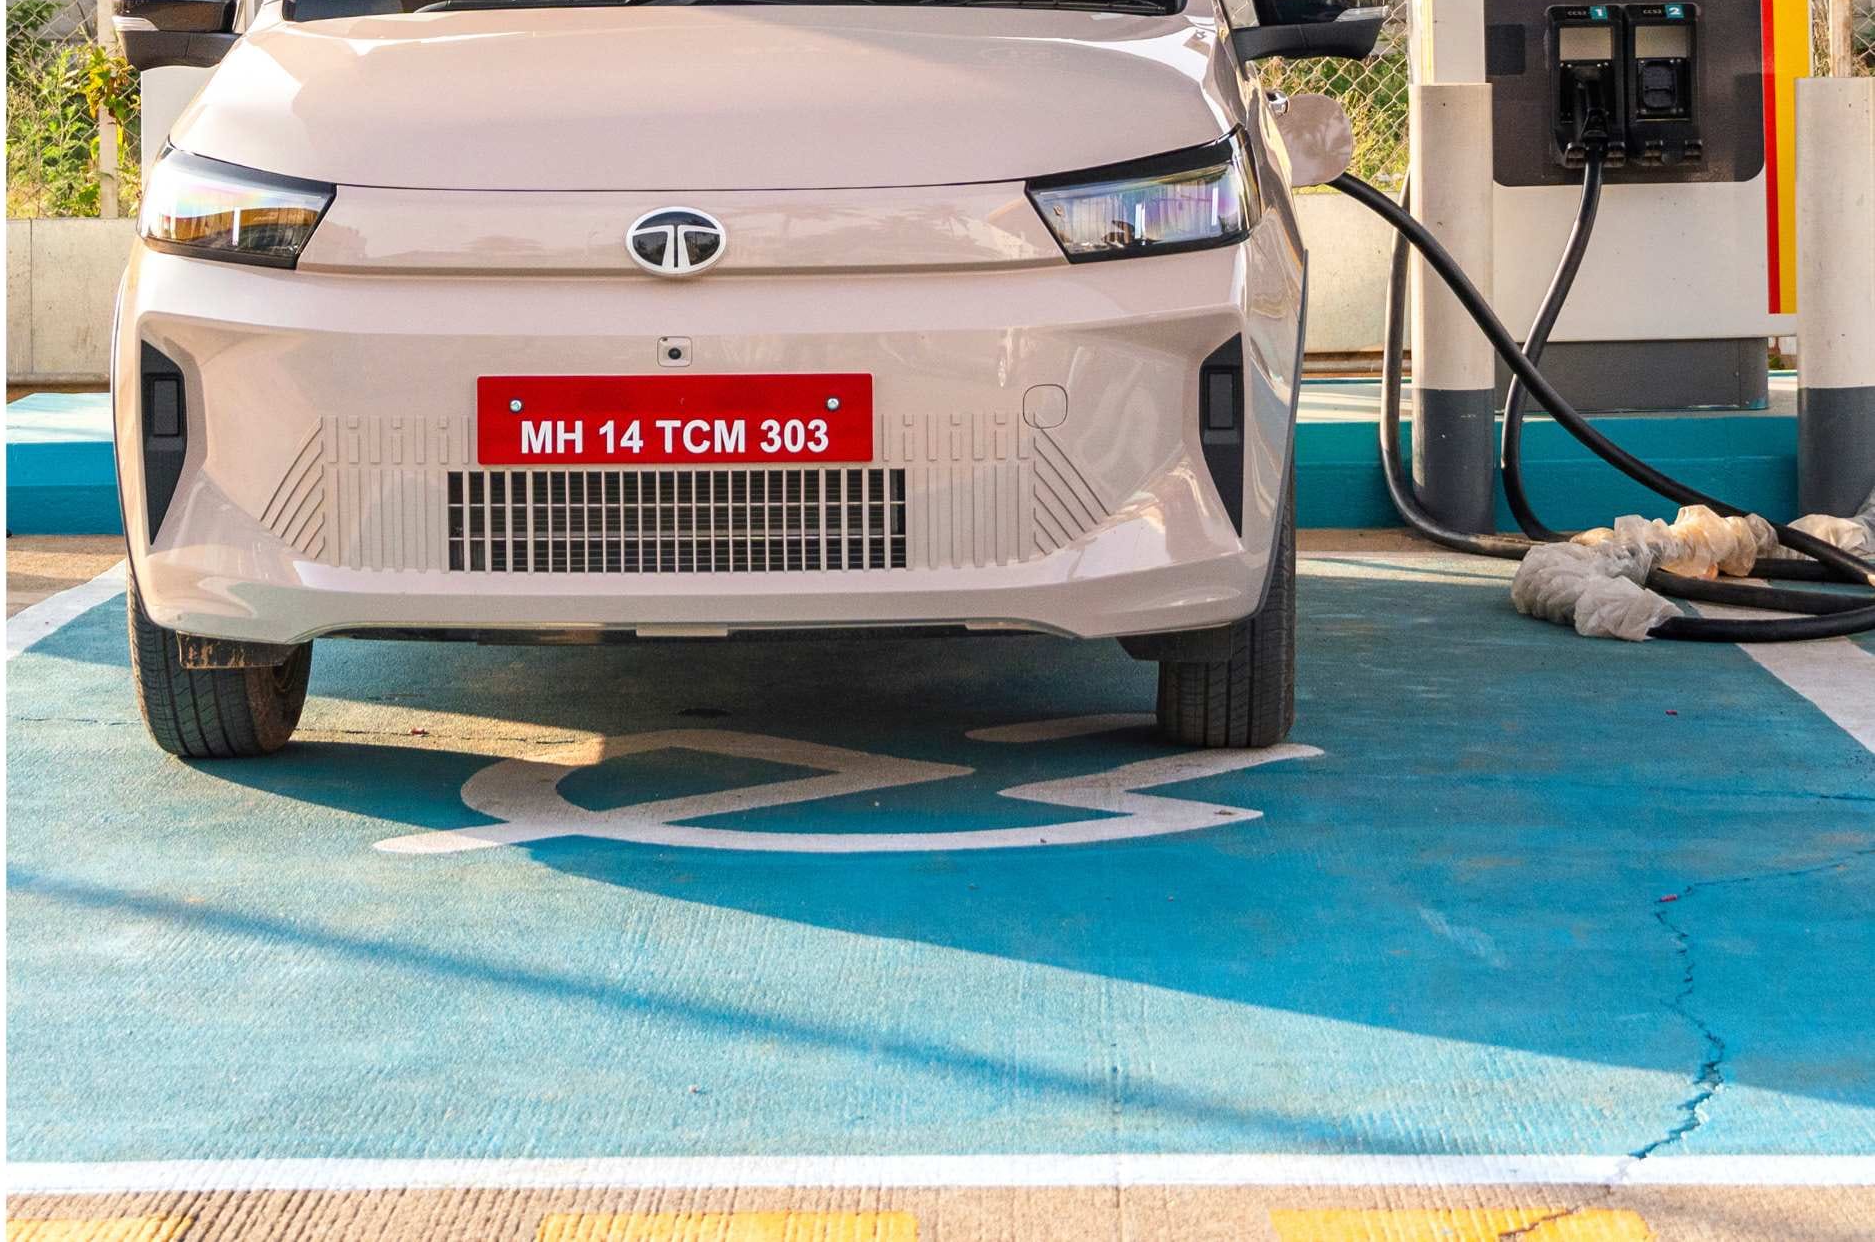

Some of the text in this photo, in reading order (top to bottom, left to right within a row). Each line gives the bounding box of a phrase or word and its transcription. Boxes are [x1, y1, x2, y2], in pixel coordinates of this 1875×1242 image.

[1595, 8, 1603, 17] 1
[1668, 7, 1681, 15] 2
[520, 419, 829, 454] MH 14 TCM 303
